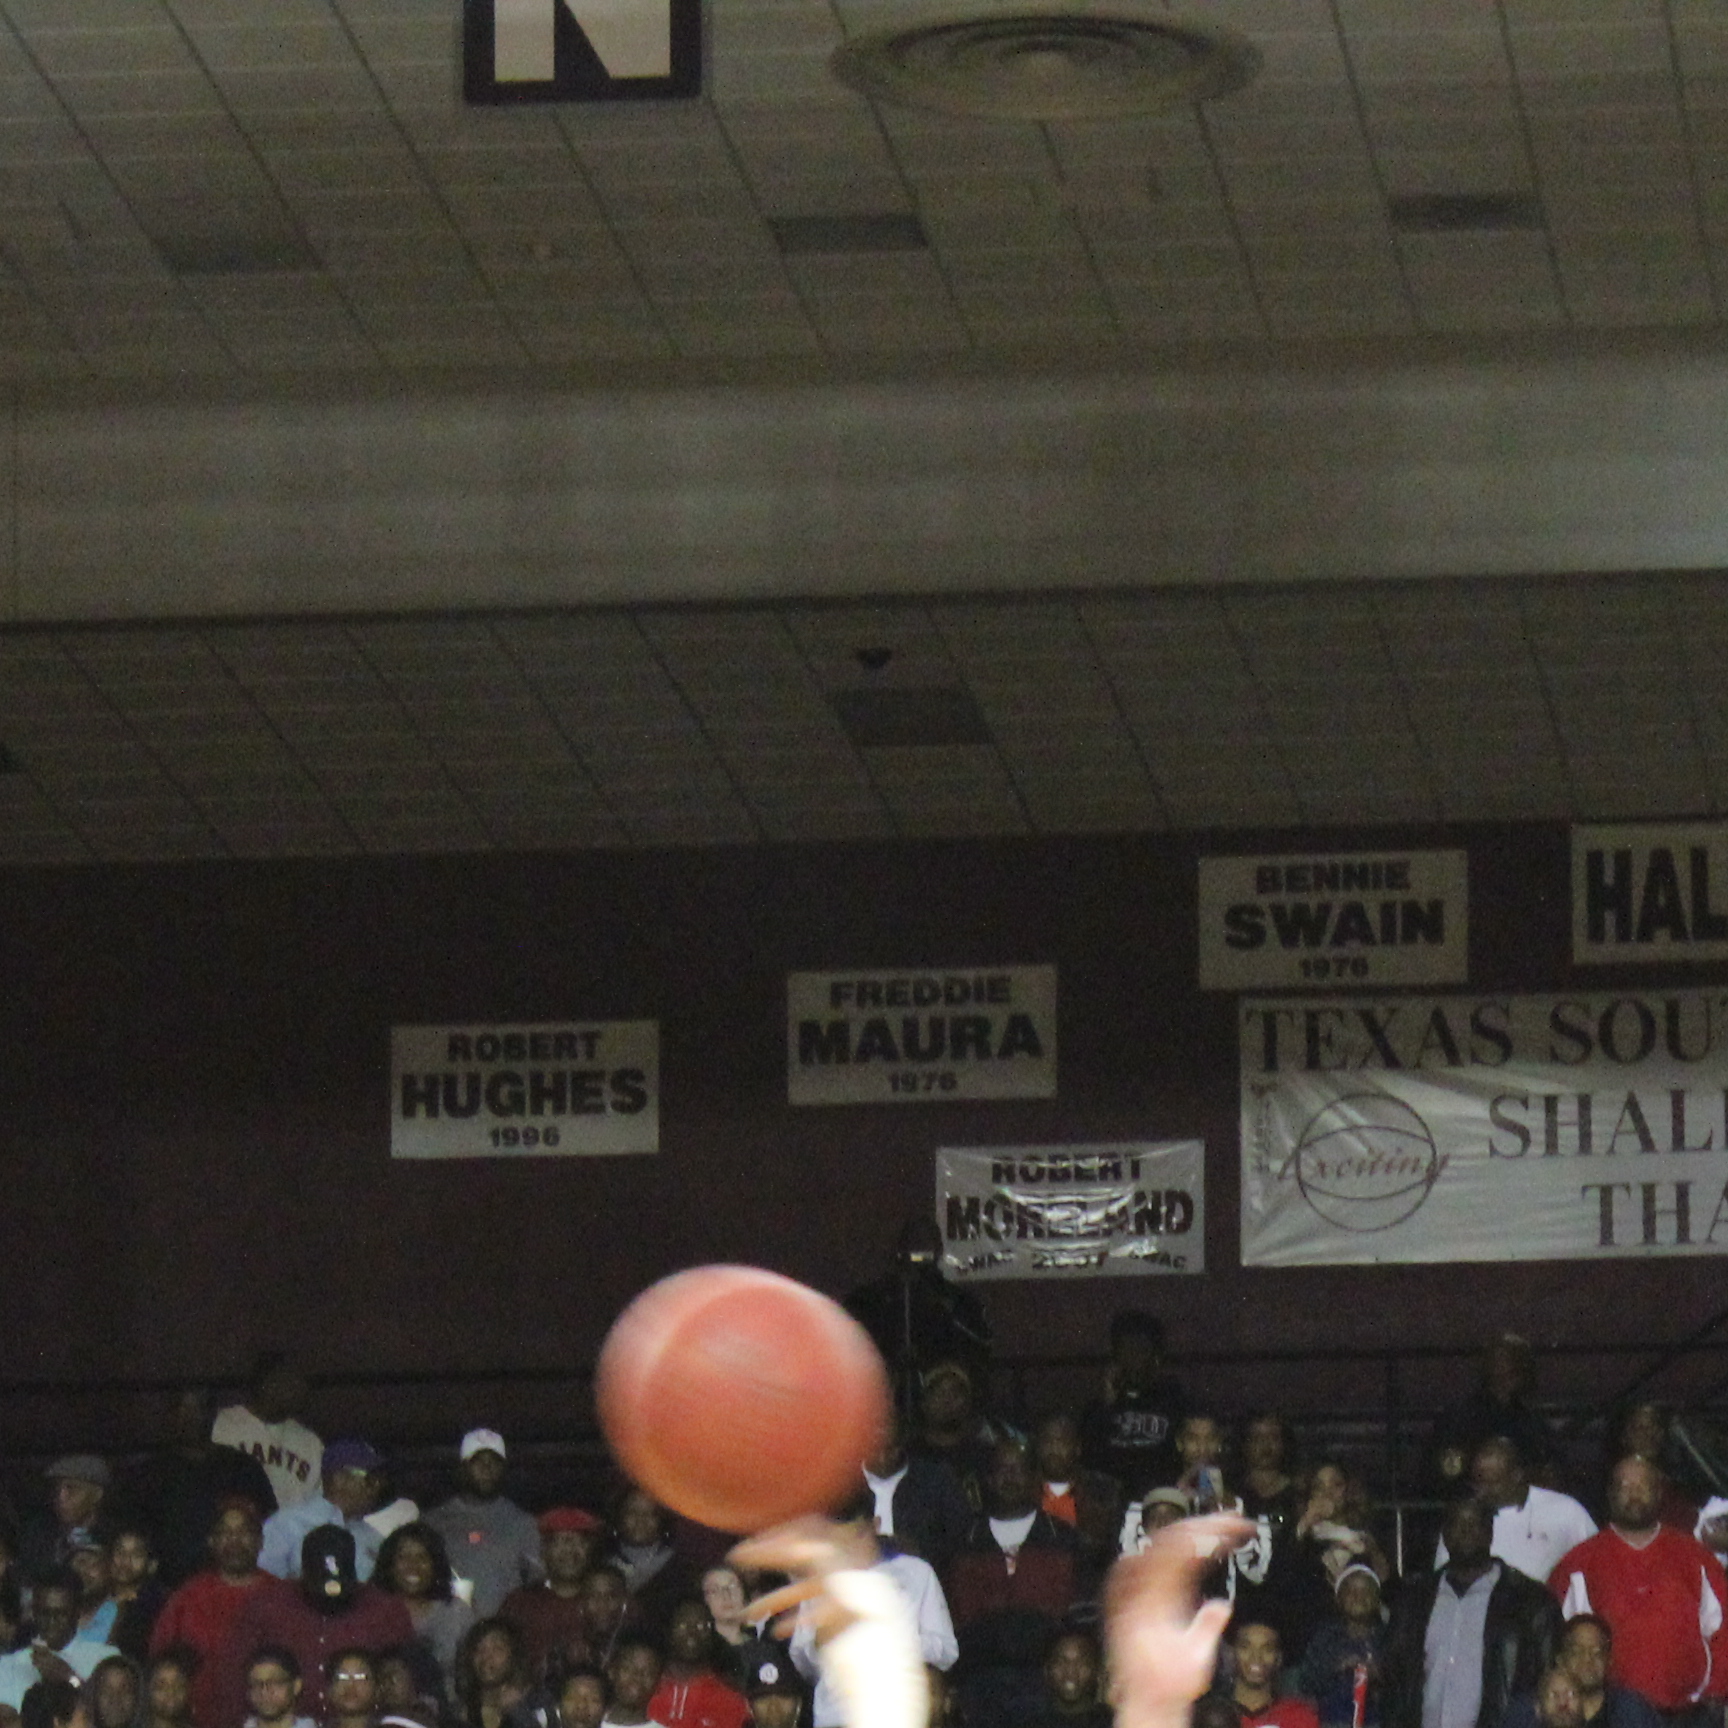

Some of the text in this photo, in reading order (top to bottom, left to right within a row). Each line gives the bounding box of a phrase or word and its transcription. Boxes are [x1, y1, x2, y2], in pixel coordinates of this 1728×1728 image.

[1255, 860, 1412, 895] BENNIE
[1223, 899, 1447, 951] SWAIN
[829, 975, 1012, 1010] FREDDIE
[447, 1031, 602, 1063] ROBERT
[797, 1012, 1042, 1066] MAURA
[1245, 1002, 1514, 1073] TEXAS
[400, 1069, 648, 1121] HUGHES
[991, 1151, 1142, 1184] ROBERT
[237, 1440, 312, 1485] IANTS
